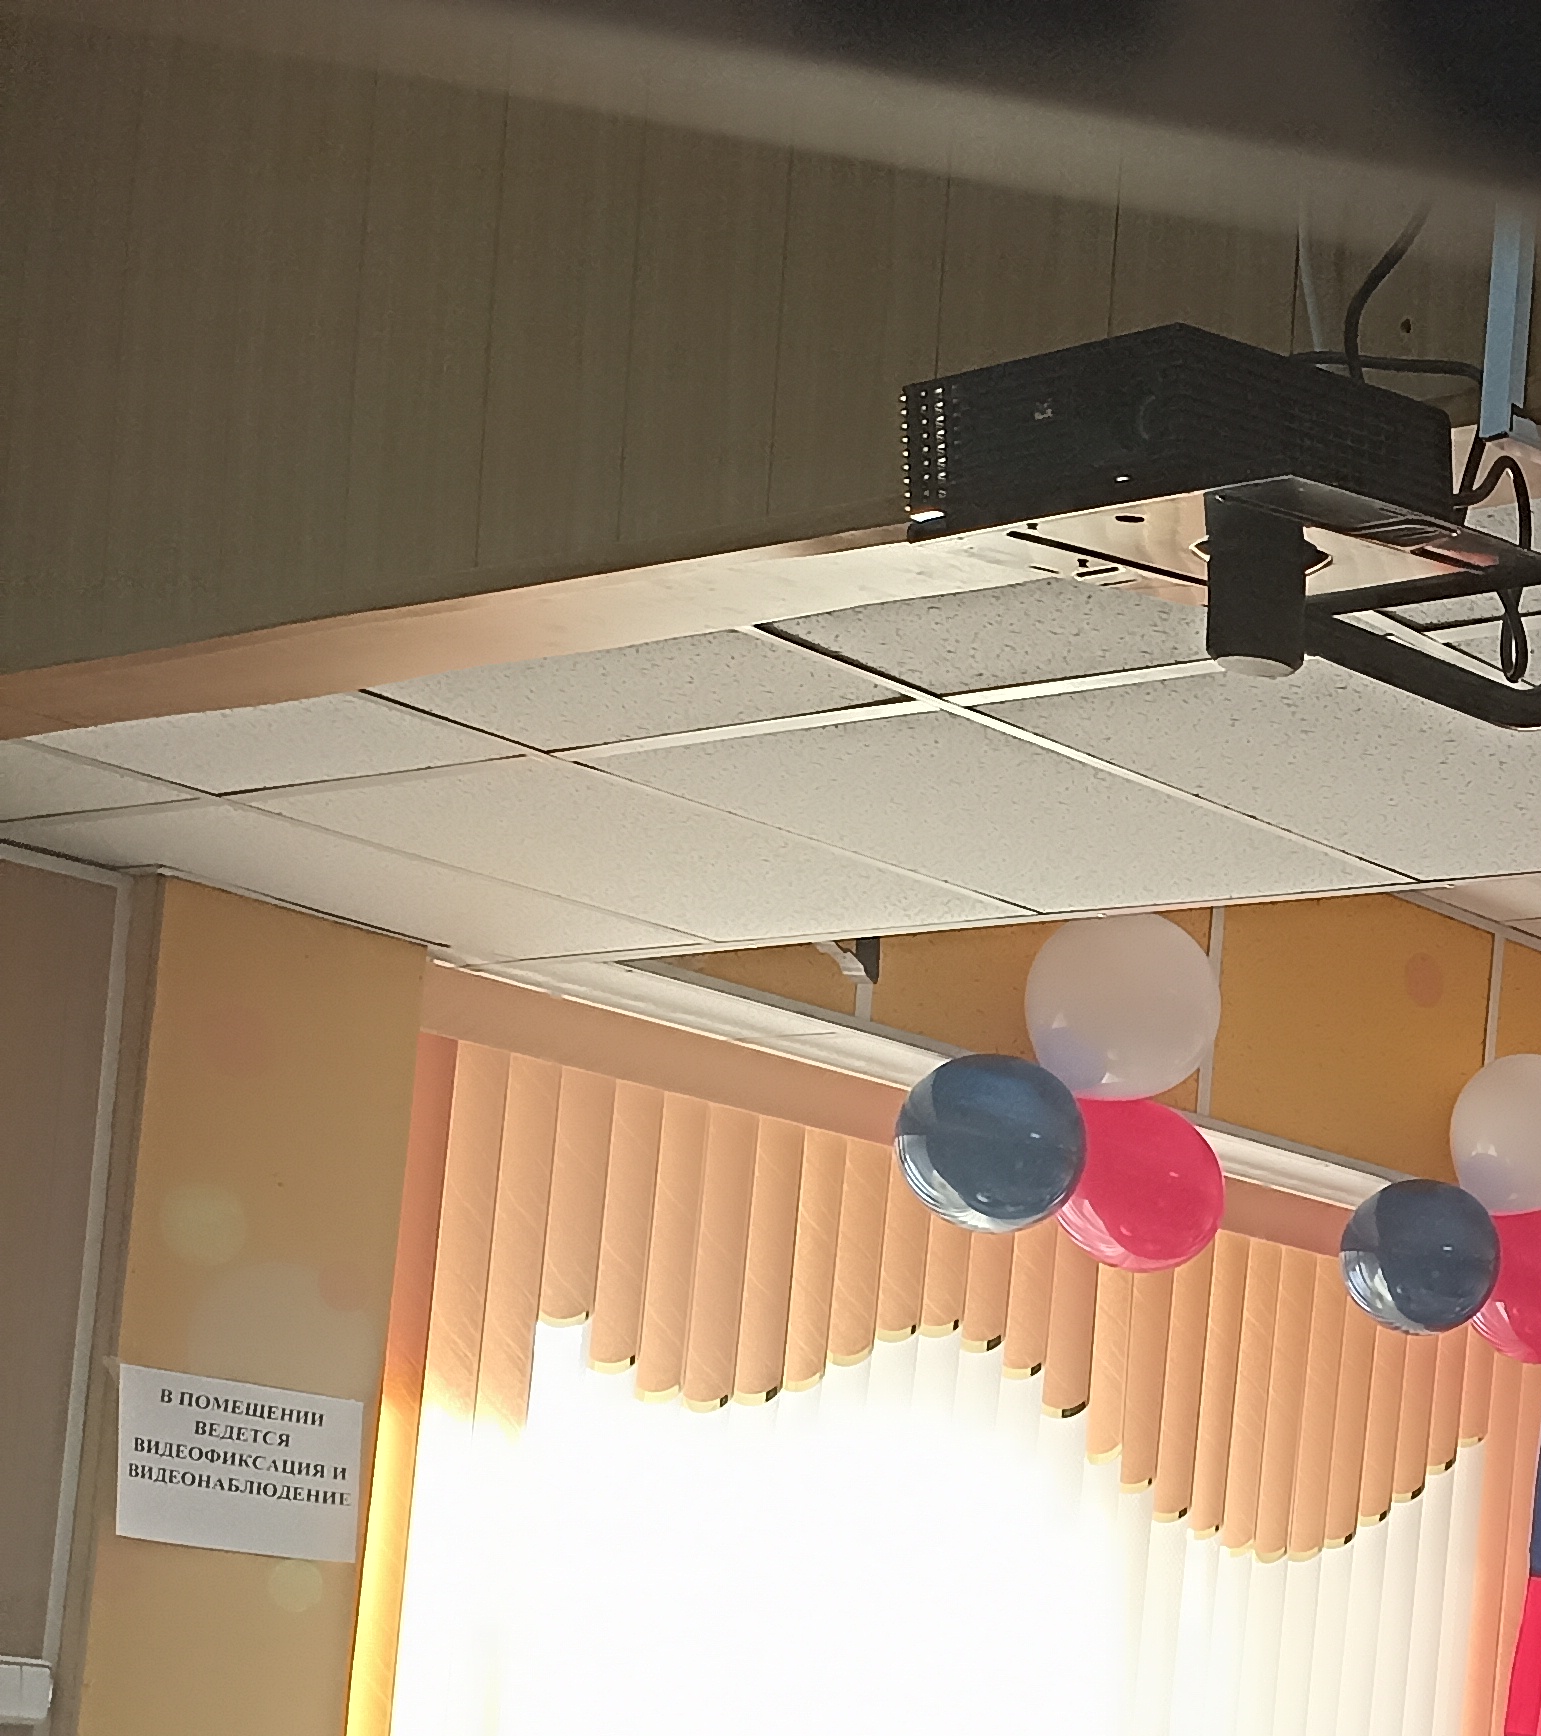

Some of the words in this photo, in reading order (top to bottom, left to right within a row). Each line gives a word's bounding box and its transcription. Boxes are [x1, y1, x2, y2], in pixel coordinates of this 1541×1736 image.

[161, 1388, 173, 1404] В
[179, 1391, 325, 1427] ПОМЕЩЕНИИ
[195, 1420, 290, 1447] ВЕДЕТСЯ
[134, 1437, 325, 1478] ВИДЕОФИКСАЦИЯ
[333, 1466, 347, 1480] И
[128, 1462, 352, 1506] ВИДЕОНАБЛЮДЕНИЕ
